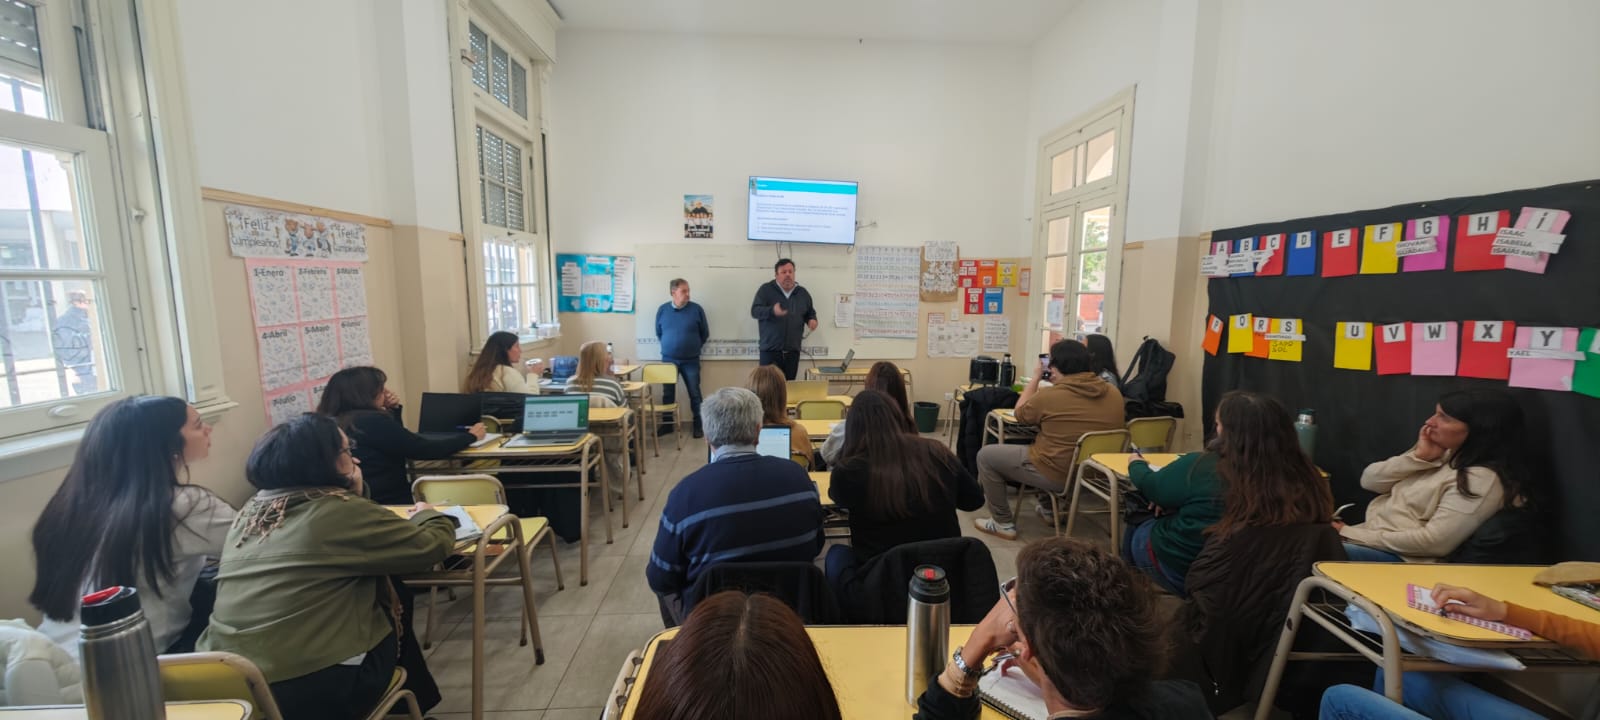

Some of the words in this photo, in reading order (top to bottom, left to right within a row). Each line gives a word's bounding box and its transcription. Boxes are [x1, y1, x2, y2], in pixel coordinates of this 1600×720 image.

[1423, 220, 1432, 235] G
[1477, 215, 1490, 232] H
[1337, 232, 1345, 244] E
[1379, 226, 1388, 240] F
[1499, 229, 1526, 238] ISAAC
[1270, 237, 1277, 248] C
[1301, 234, 1307, 245] D
[1495, 238, 1533, 248] ISABELLA
[1219, 243, 1225, 252] A
[1244, 240, 1250, 251] B
[253, 268, 284, 277] 1-Enero
[1258, 319, 1264, 330] R
[1285, 321, 1292, 332] S
[1351, 325, 1360, 337] U
[1388, 325, 1399, 340] V
[1428, 324, 1442, 339] W
[1481, 324, 1495, 339] X
[1540, 330, 1556, 347] Y
